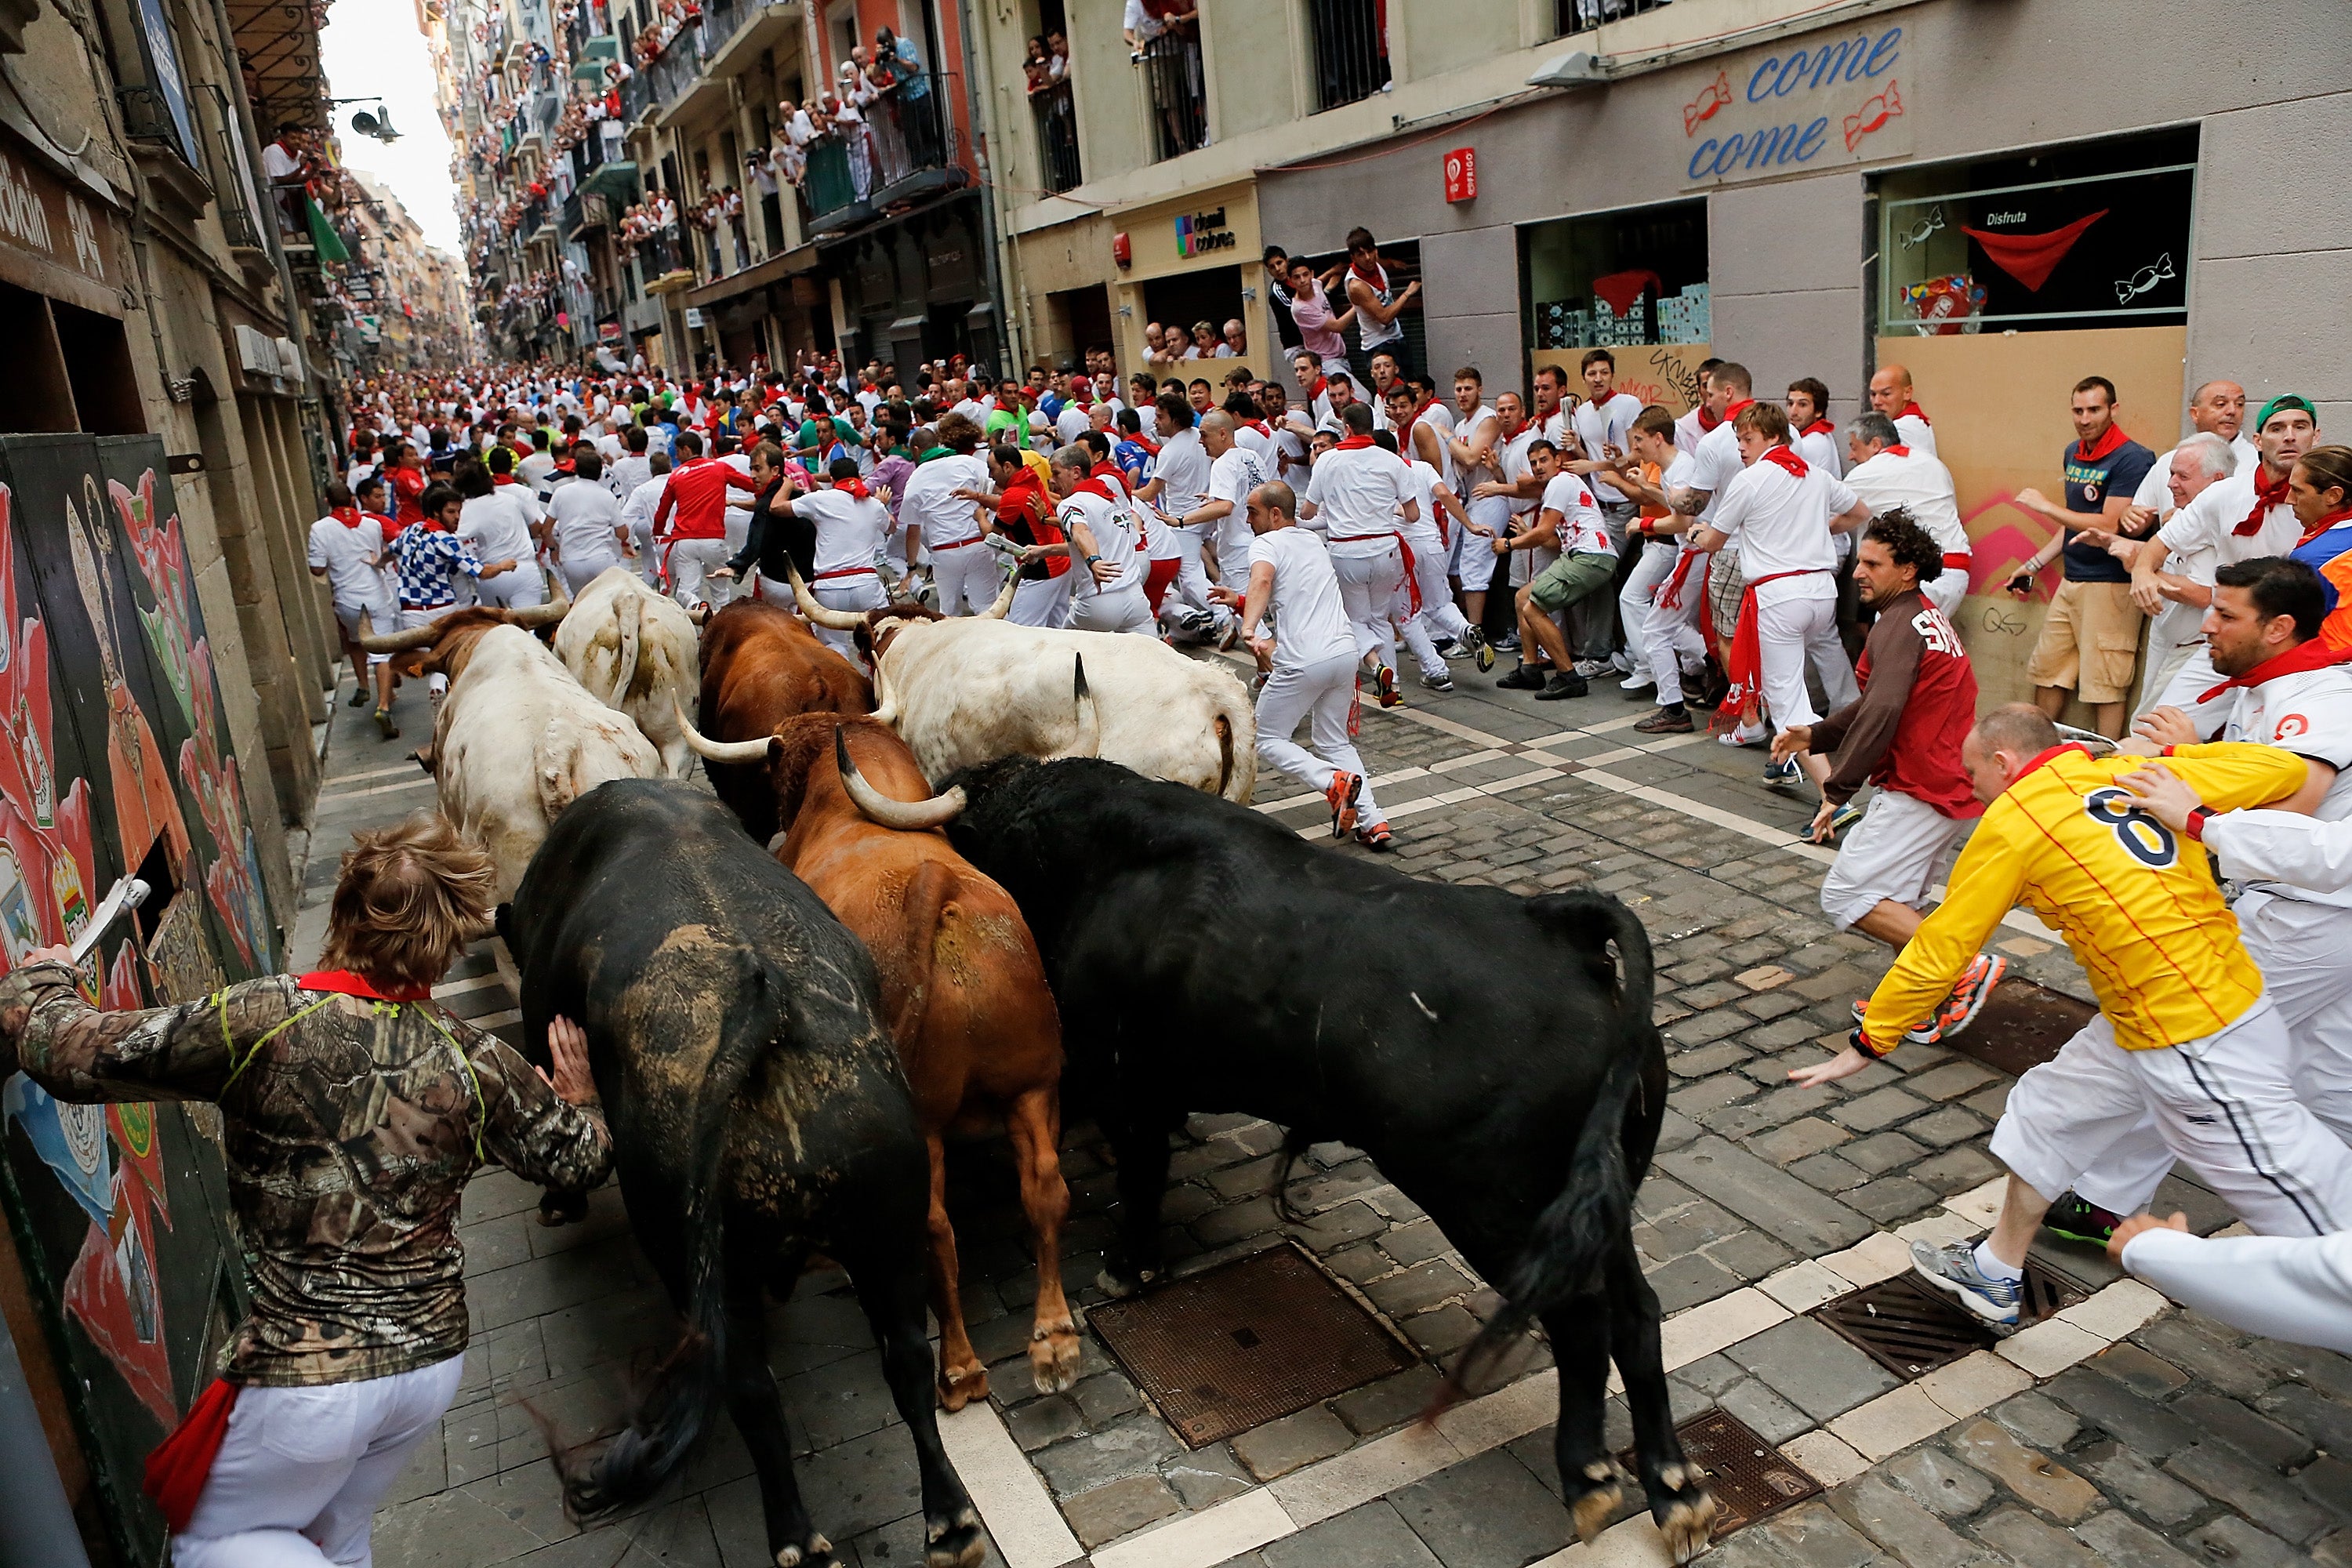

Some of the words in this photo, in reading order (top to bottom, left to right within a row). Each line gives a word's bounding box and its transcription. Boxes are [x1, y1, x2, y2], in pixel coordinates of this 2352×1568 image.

[1747, 27, 1902, 103] come
[1688, 117, 1828, 179] come
[1196, 230, 1236, 251] colores
[1987, 212, 2027, 226] Disfruta
[2085, 786, 2179, 869] 8
